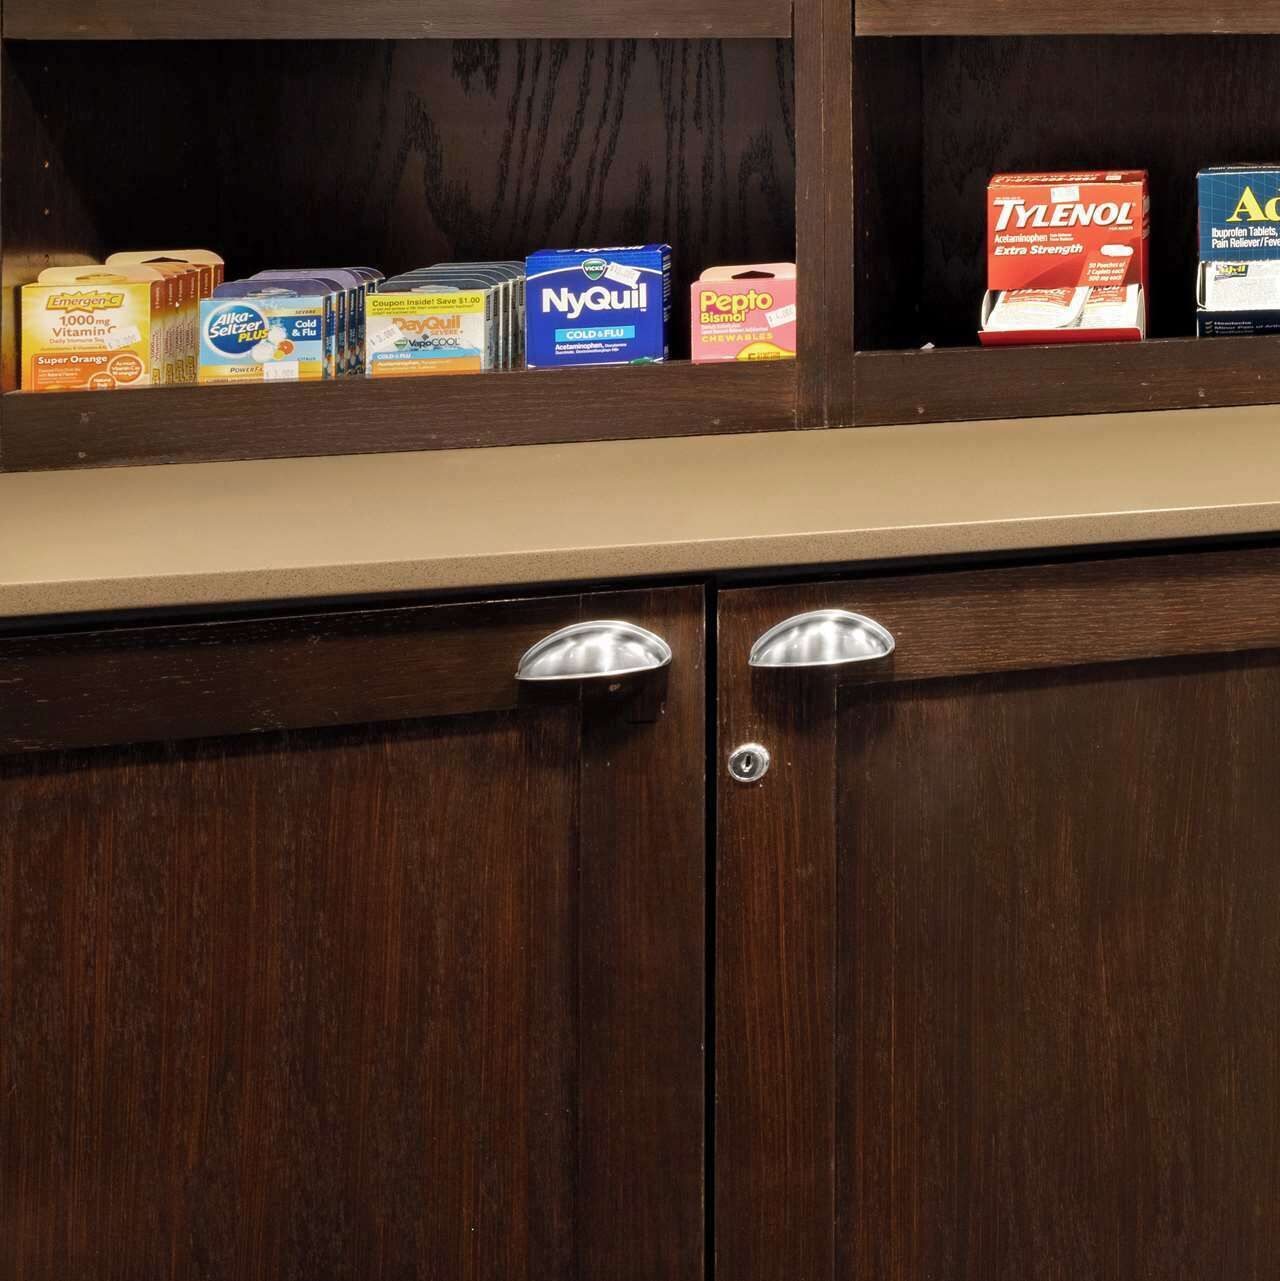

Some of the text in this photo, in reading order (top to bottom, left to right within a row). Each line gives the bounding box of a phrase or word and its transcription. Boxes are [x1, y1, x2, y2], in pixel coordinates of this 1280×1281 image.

[993, 196, 1134, 232] TYLENOL
[1211, 226, 1248, 238] Ibuprofen
[1248, 226, 1278, 237] Tablets,
[994, 233, 1048, 244] Acetaminophen
[1211, 238, 1229, 249] Pain
[994, 243, 1084, 256] Extra Strength
[1096, 261, 1117, 269] Pouches
[1091, 269, 1112, 277] Caplets
[51, 295, 121, 307] Emergen-C
[372, 299, 405, 309] Coupon
[406, 298, 434, 306] Inside!
[436, 297, 457, 305] Save
[458, 297, 481, 305] $1.00
[541, 282, 647, 319] NyQuil
[699, 288, 774, 315] Pepto
[214, 311, 254, 327] Alka-
[700, 310, 747, 324] Bismol
[208, 320, 264, 339] Seltzer
[295, 319, 317, 328] Cold
[238, 328, 270, 343] PLUS
[291, 328, 317, 337] & Flu
[701, 332, 774, 344] CHEWABLES
[408, 336, 461, 349] VapoCOOL
[37, 355, 108, 366] Super Orange
